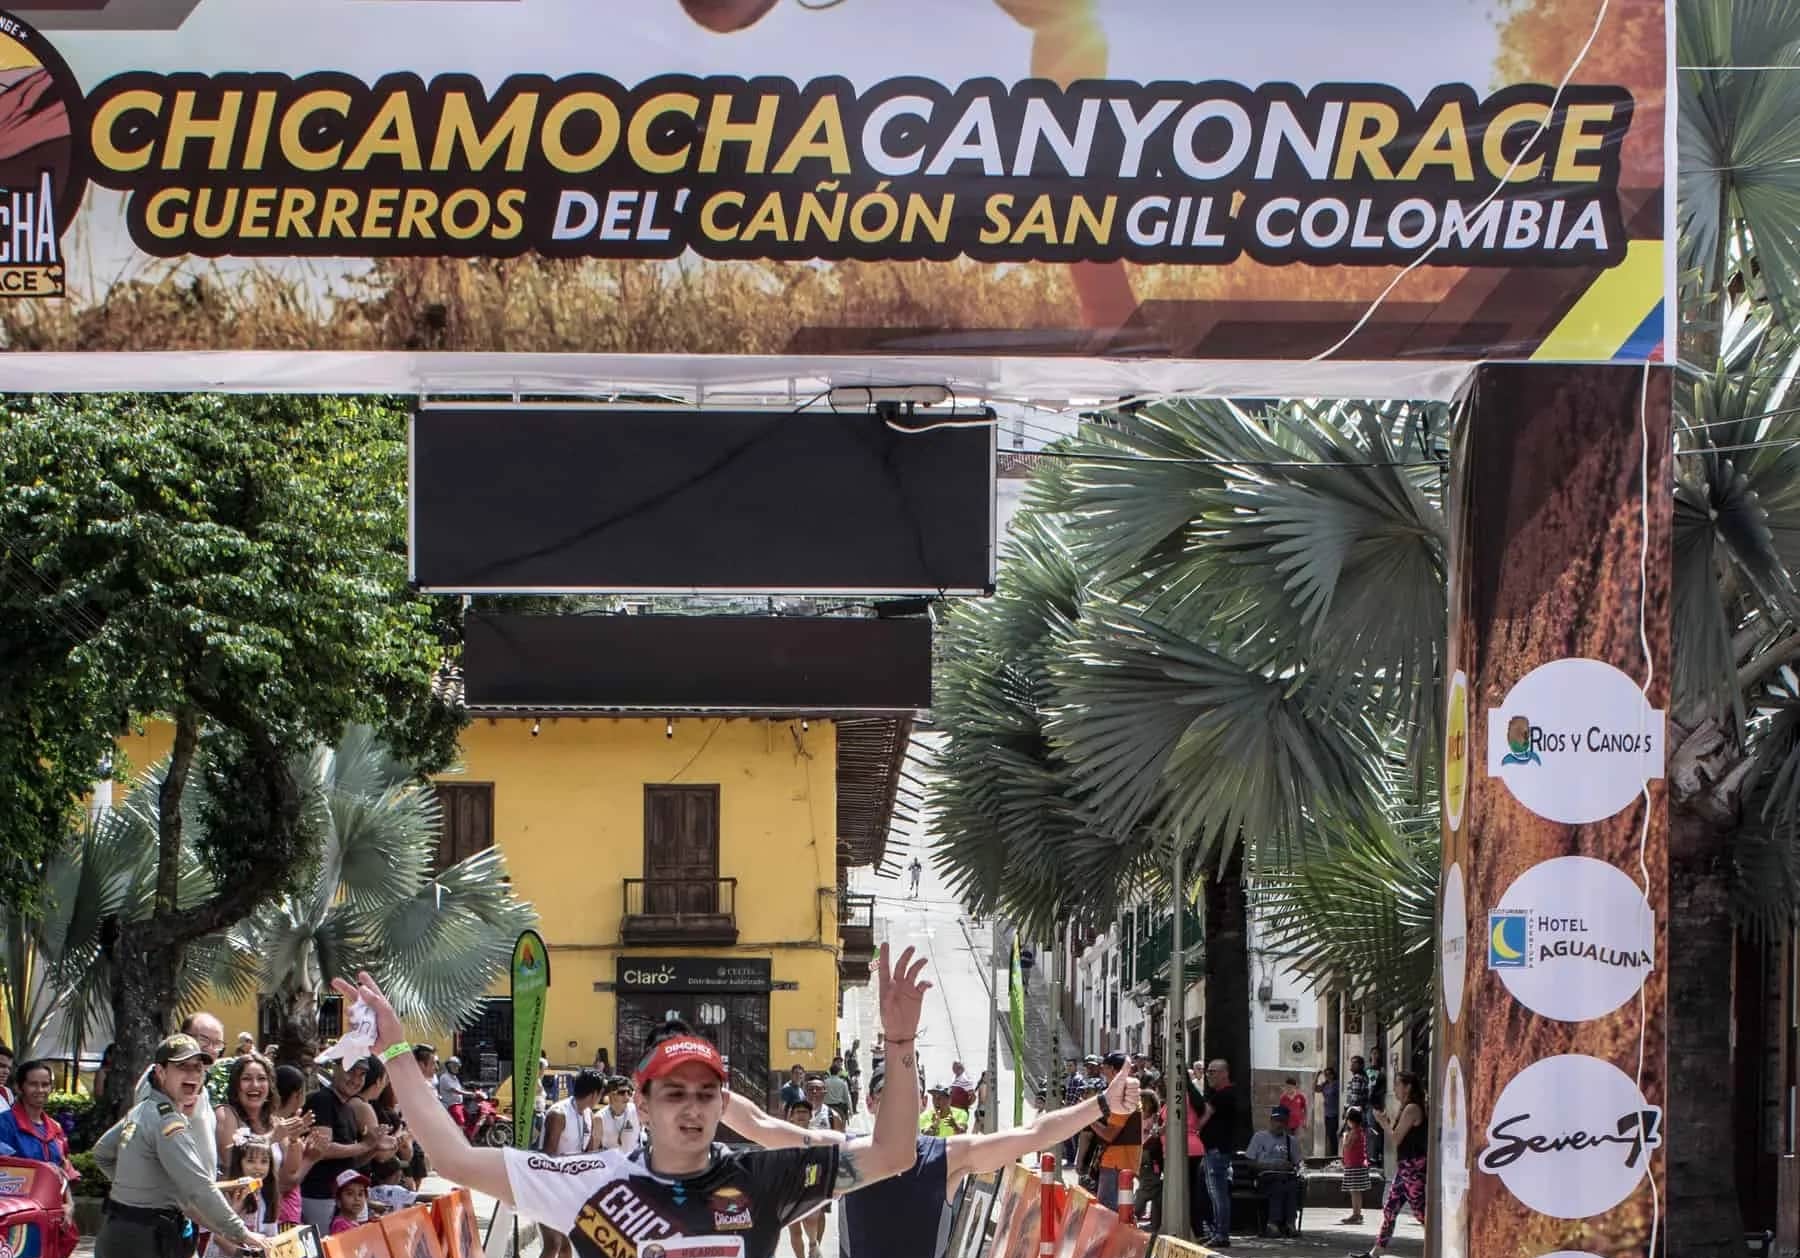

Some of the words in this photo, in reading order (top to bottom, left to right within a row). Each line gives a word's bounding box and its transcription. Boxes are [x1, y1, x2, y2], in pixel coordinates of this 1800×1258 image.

[145, 187, 527, 241] GUERREROS
[699, 181, 949, 245] CAÑÓN
[1255, 197, 1609, 250] COLOMBIA
[1538, 916, 1588, 932] HOTEL
[1539, 940, 1652, 967] AGUALUNA
[623, 969, 670, 985] Claro
